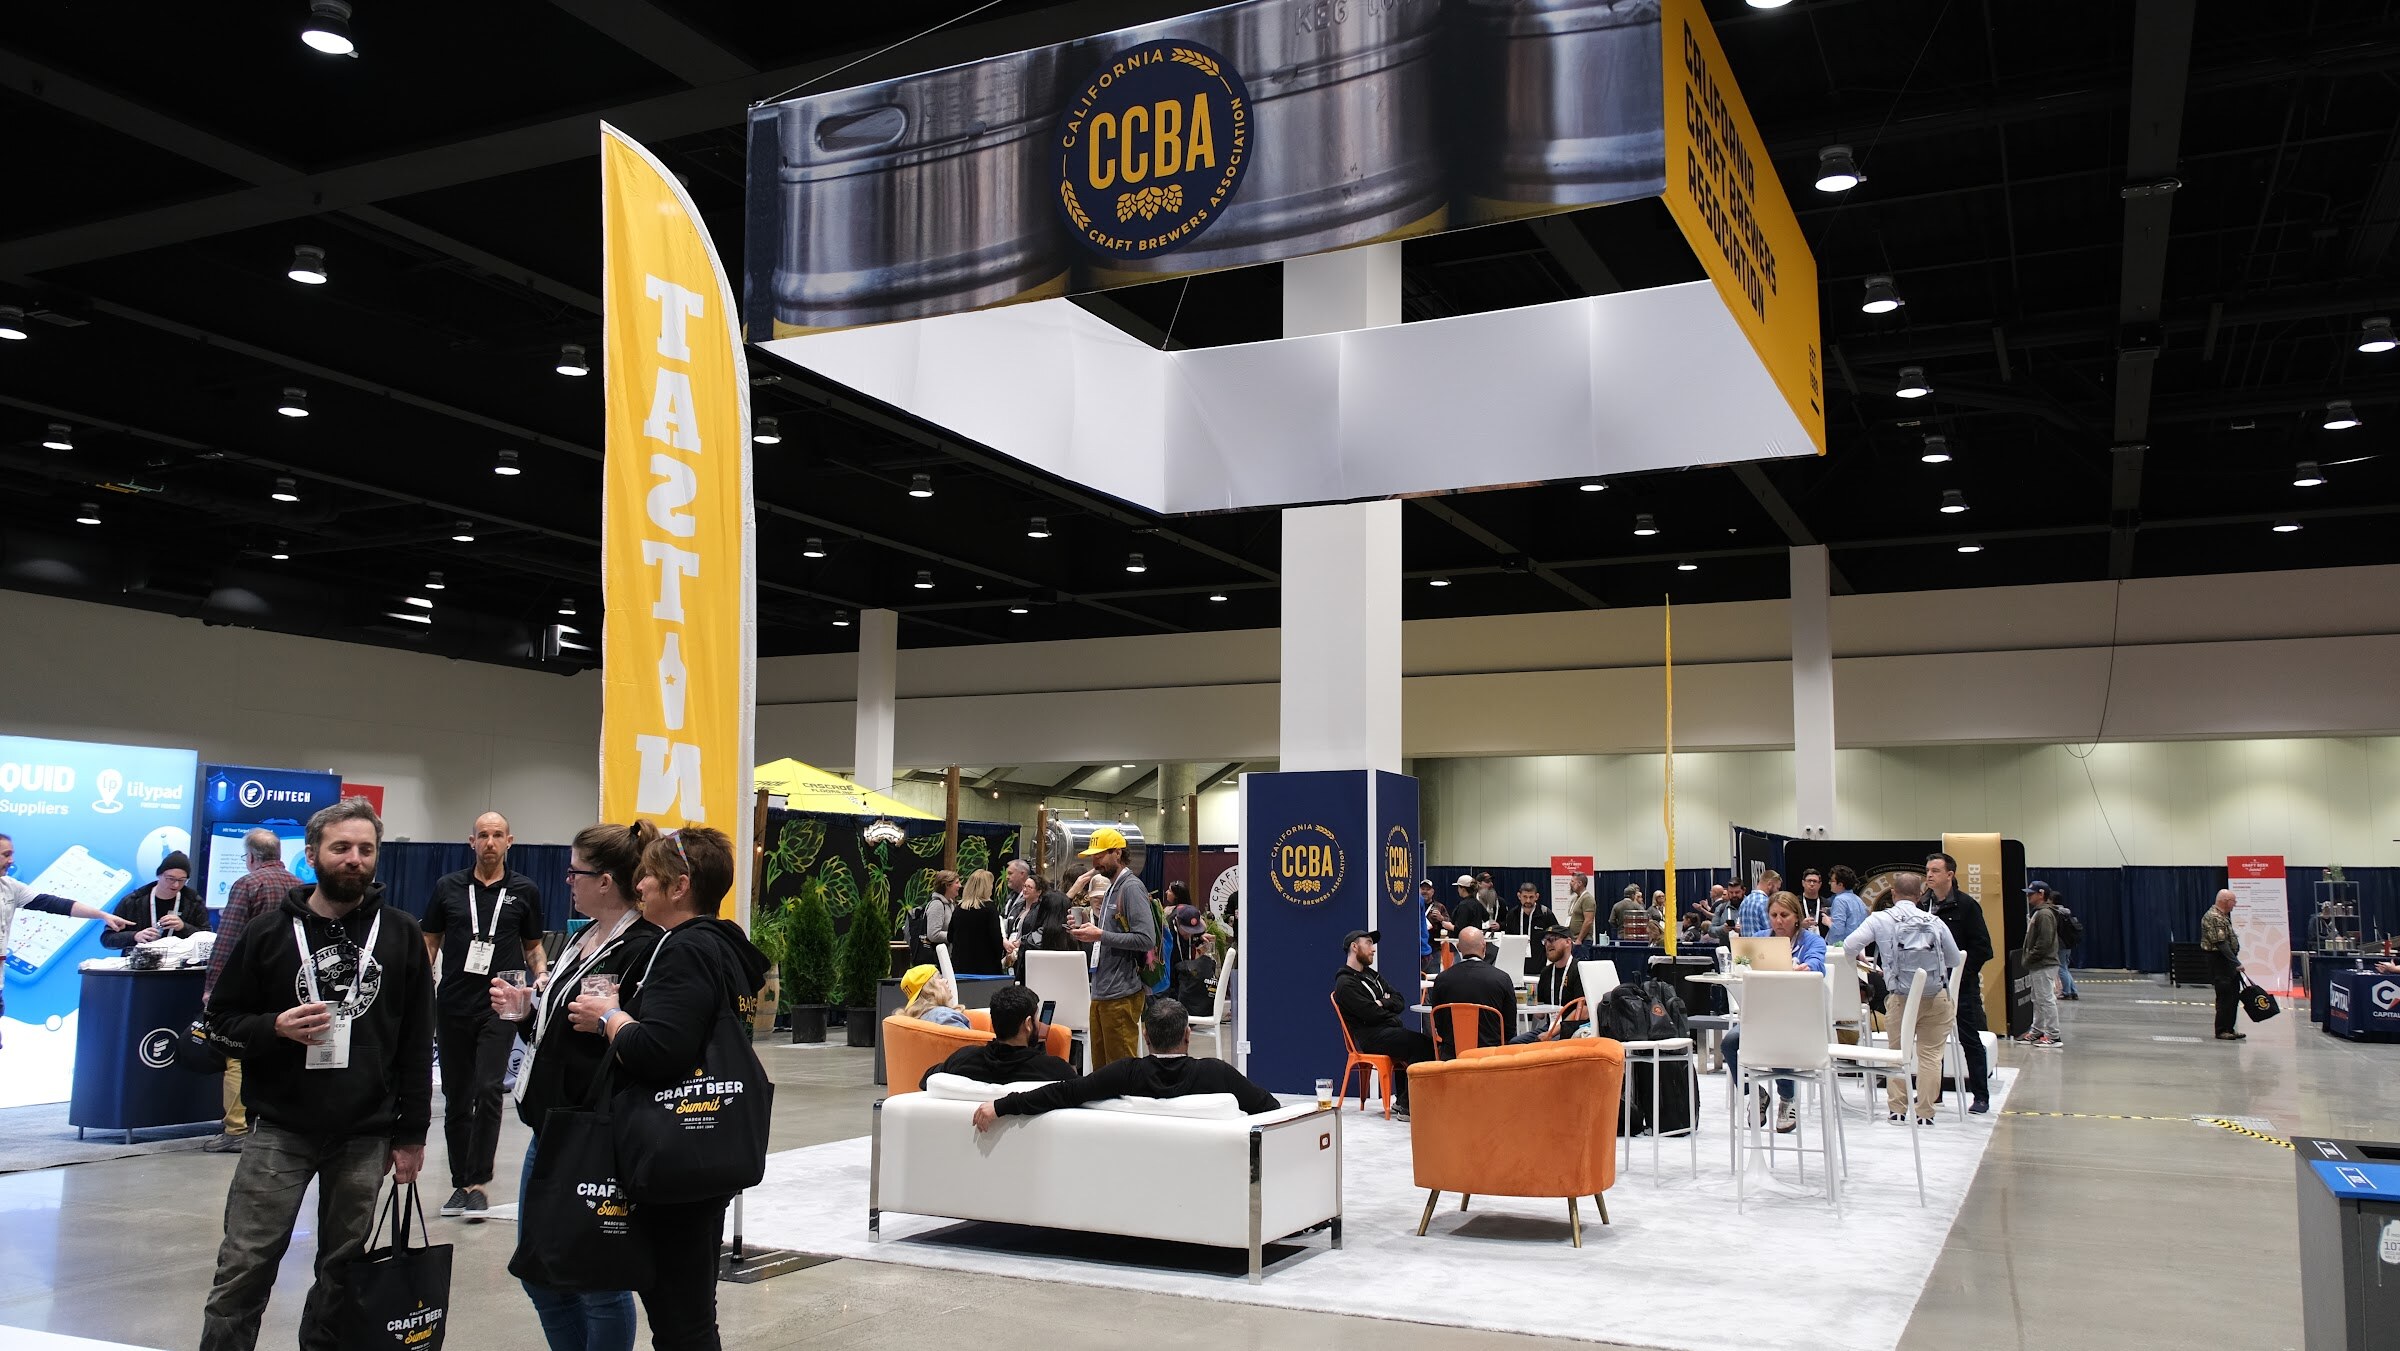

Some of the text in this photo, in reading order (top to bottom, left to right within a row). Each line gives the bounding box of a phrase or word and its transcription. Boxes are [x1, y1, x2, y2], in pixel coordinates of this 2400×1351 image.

[1062, 49, 1164, 148] CALIFORNIA
[1683, 18, 1756, 204] CALIFORNIA
[1088, 92, 1216, 190] CCBA
[1088, 97, 1245, 251] CRAFT BREWERS ASSOCIATION
[1685, 81, 1777, 297] CRAFT BREWERS
[1687, 145, 1766, 325] ASSOCIATION
[0, 762, 76, 793] QUID
[127, 781, 183, 801] lilypad
[802, 782, 854, 791] CASCADE
[0, 799, 69, 816] Suppliers
[266, 789, 311, 803] FINTECH
[1271, 824, 1313, 858] CALIFORNIA
[1282, 845, 1334, 878] CCBA
[1282, 850, 1345, 906] CRAFT BREWERS ASSOCIATION
[1389, 845, 1409, 878] CCBA
[1212, 868, 1238, 901] CRAFT
[654, 1081, 744, 1102] CRAFT BEER
[676, 1096, 720, 1114] Summit
[576, 1183, 617, 1198] CRAF
[597, 1199, 629, 1216] Sumit
[387, 1308, 443, 1331] CRAFT BEER
